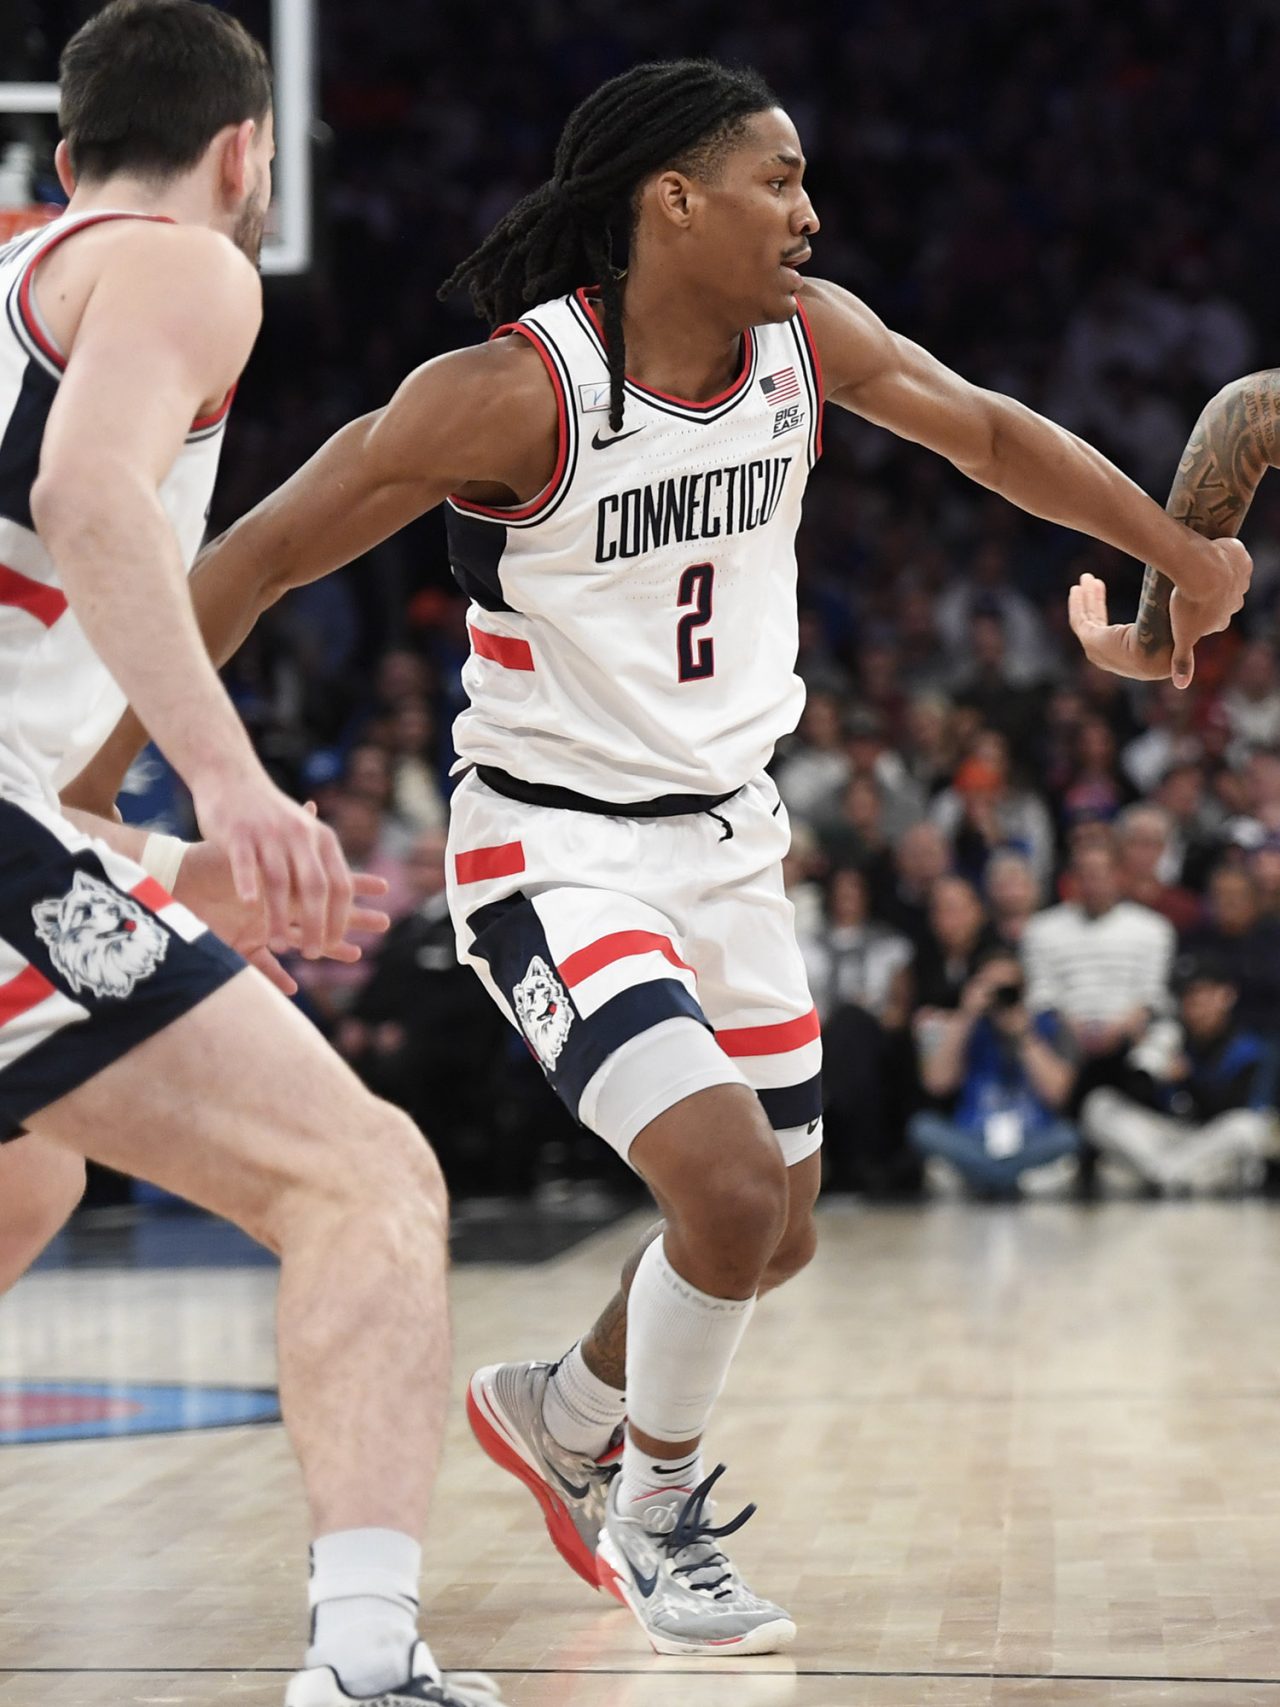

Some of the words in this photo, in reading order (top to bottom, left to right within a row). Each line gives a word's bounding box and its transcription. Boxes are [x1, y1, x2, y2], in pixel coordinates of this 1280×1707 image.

[773, 411, 805, 433] EAST
[775, 404, 799, 422] BIG
[595, 457, 792, 563] CONNECTICUT
[677, 562, 714, 683] 2
